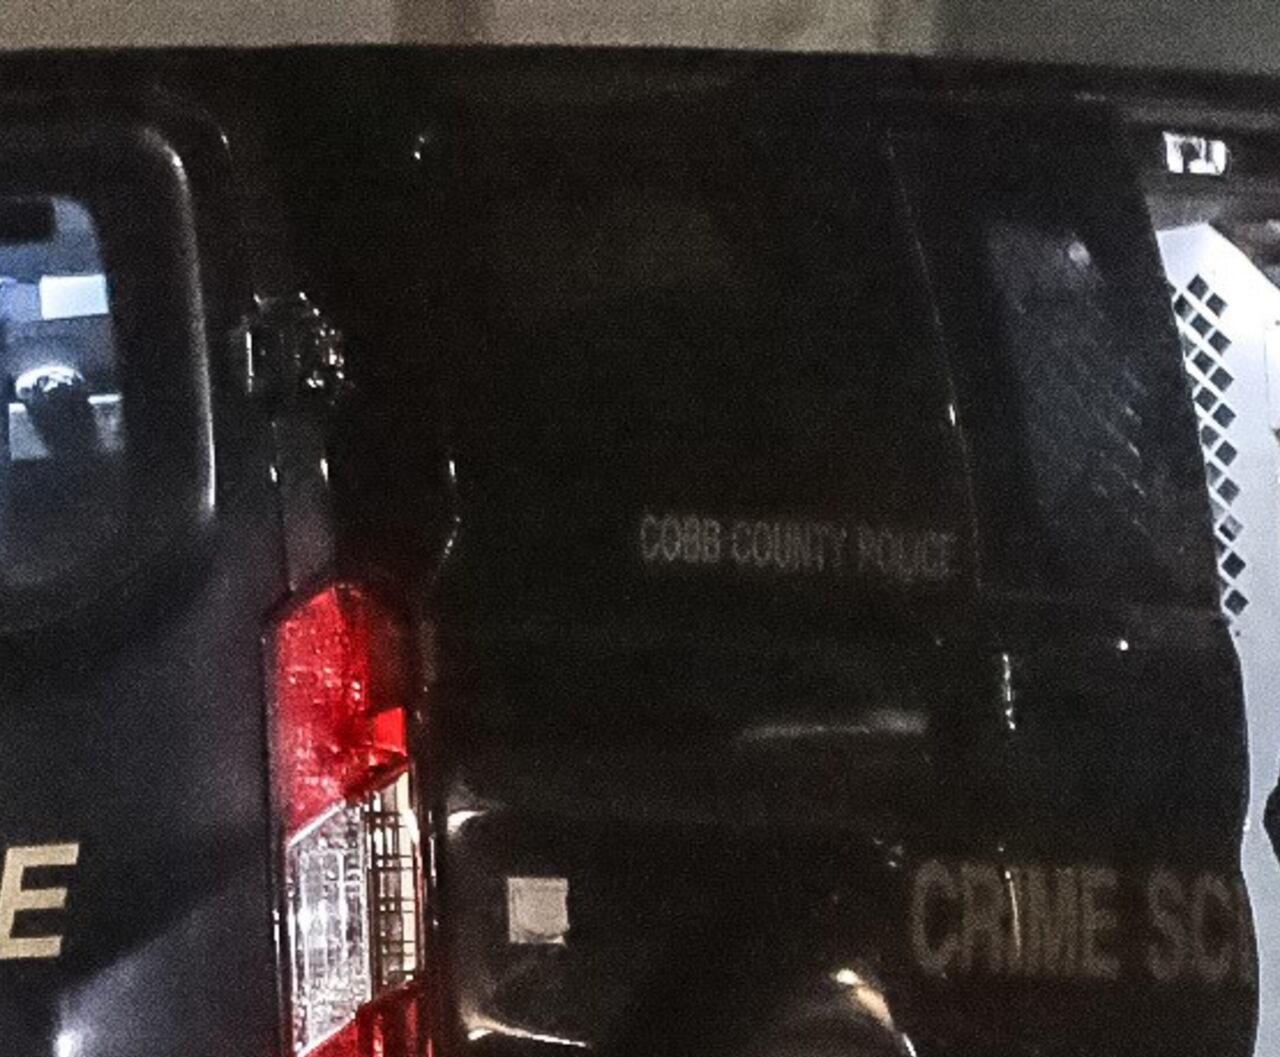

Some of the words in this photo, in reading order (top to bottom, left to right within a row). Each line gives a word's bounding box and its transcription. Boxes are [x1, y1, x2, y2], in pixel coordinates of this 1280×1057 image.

[640, 514, 720, 563] COBB
[732, 520, 848, 573] COUNTY
[911, 858, 1120, 977] CRIME
